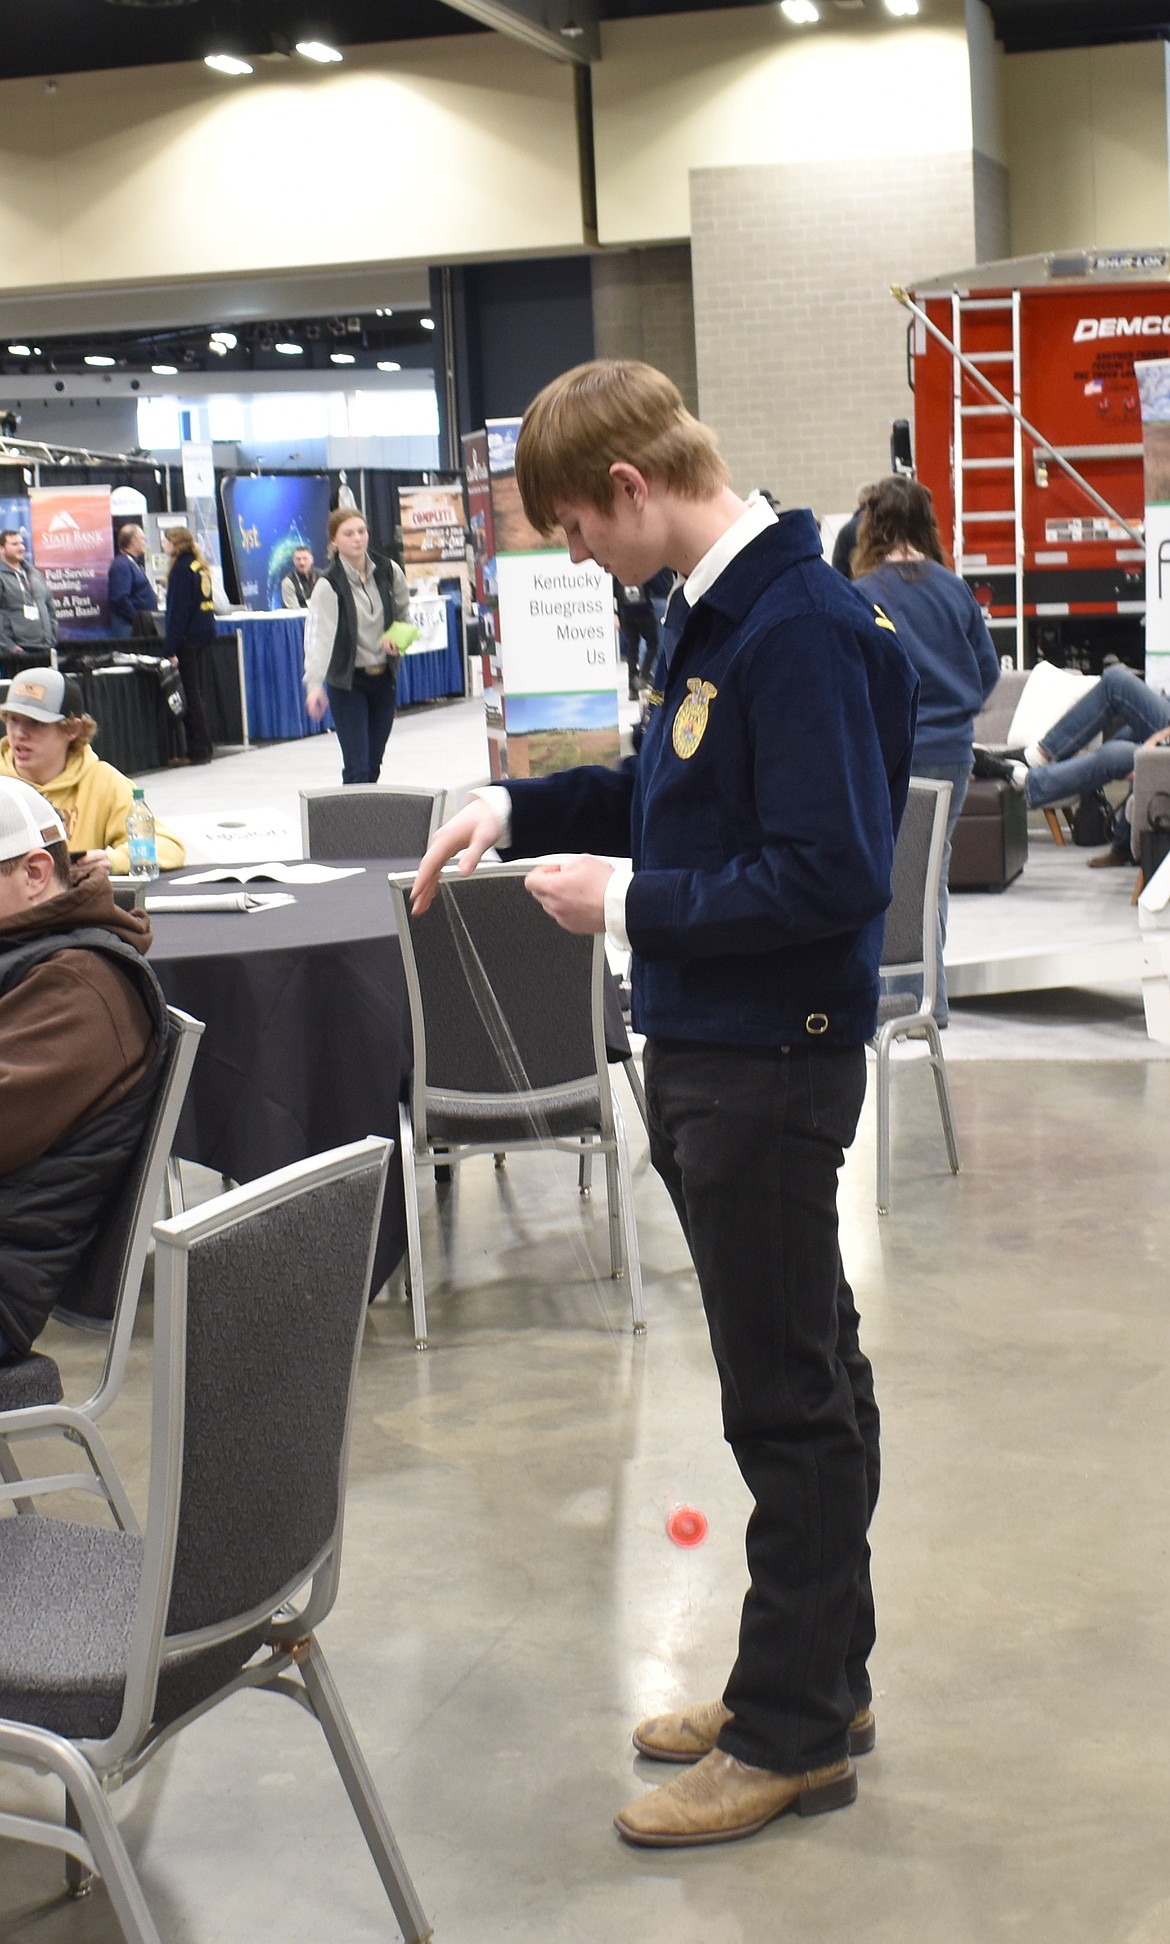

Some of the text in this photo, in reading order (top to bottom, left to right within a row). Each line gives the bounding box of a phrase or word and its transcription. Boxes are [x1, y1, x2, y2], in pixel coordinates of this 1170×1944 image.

[42, 529, 104, 544] STATE BANK
[533, 571, 602, 591] Kentucky
[62, 596, 71, 607] A
[71, 595, 91, 607] First
[529, 599, 604, 619] Bluegrass
[55, 604, 100, 618] ame Basis!
[556, 623, 605, 641] Moves
[586, 648, 606, 665] Us
